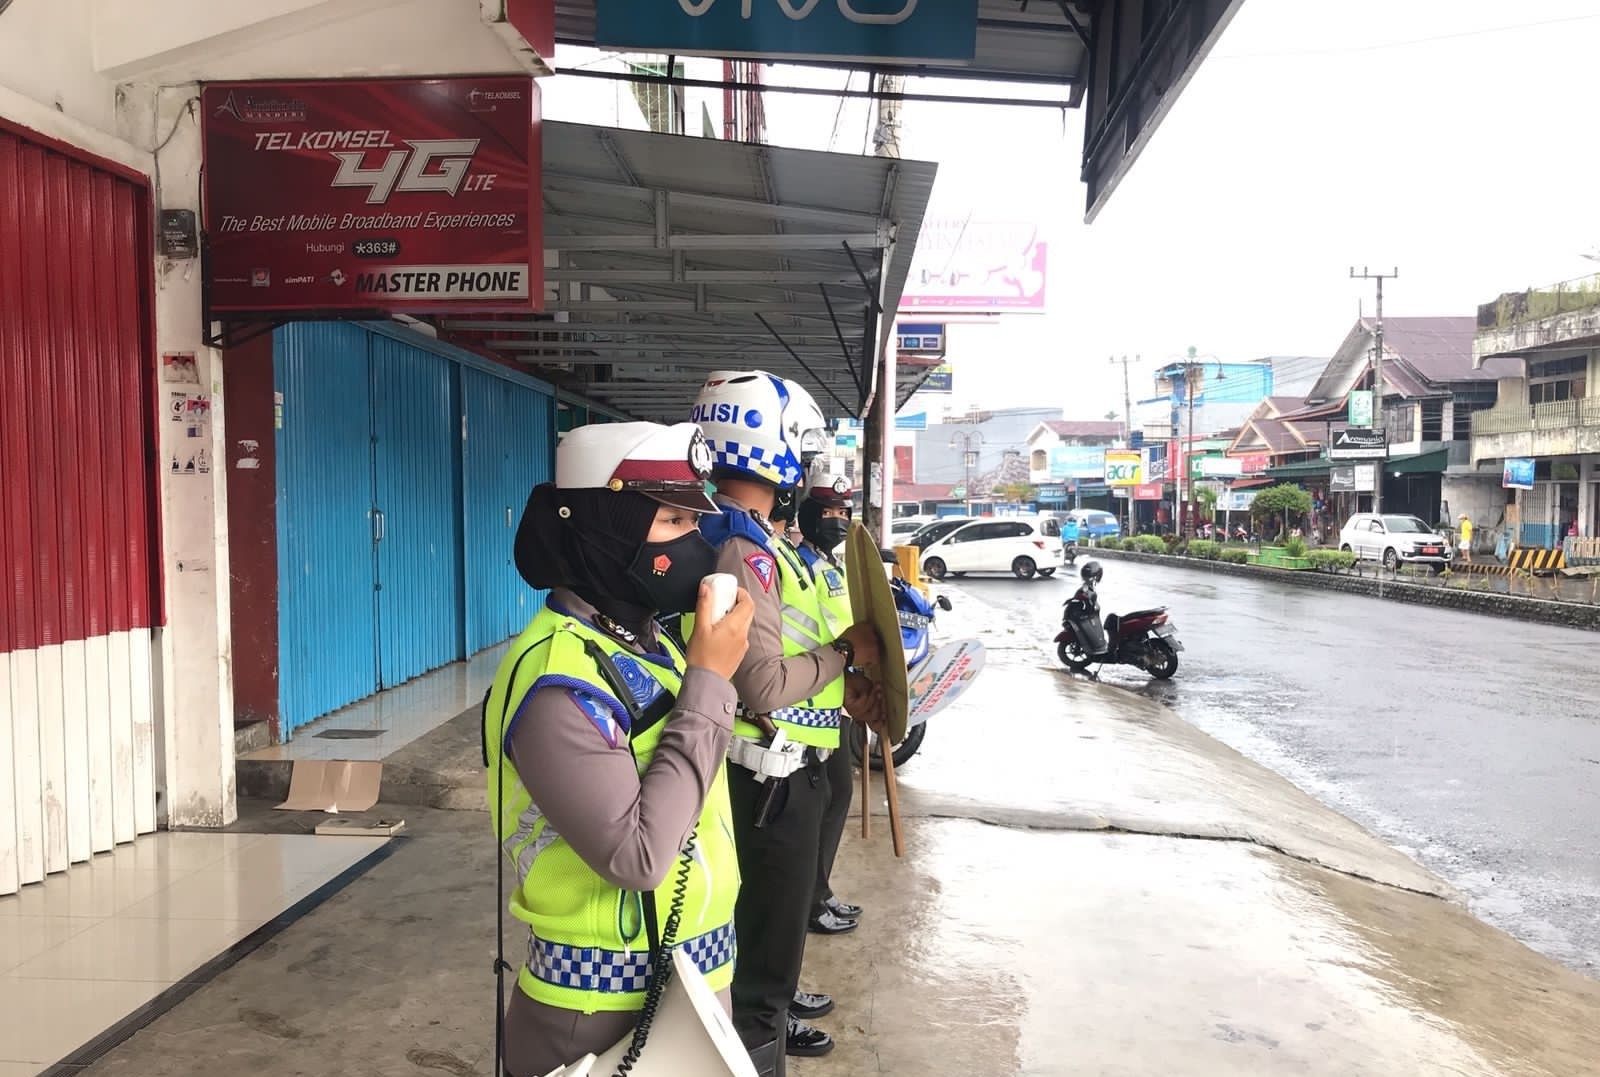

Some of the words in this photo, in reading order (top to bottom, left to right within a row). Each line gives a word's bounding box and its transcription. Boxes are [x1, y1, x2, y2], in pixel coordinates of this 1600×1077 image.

[254, 130, 394, 150] TELKOMSEL
[330, 139, 480, 203] 4G
[463, 174, 497, 191] LTE
[220, 216, 247, 232] The
[250, 215, 286, 231] Best
[287, 214, 336, 230] Mobile
[340, 214, 422, 229] Broadband
[424, 211, 515, 228] Experiences
[306, 243, 345, 253] Hubungi
[357, 273, 440, 293] MASTER
[446, 271, 520, 291] PHONE
[691, 403, 740, 424] OLISI
